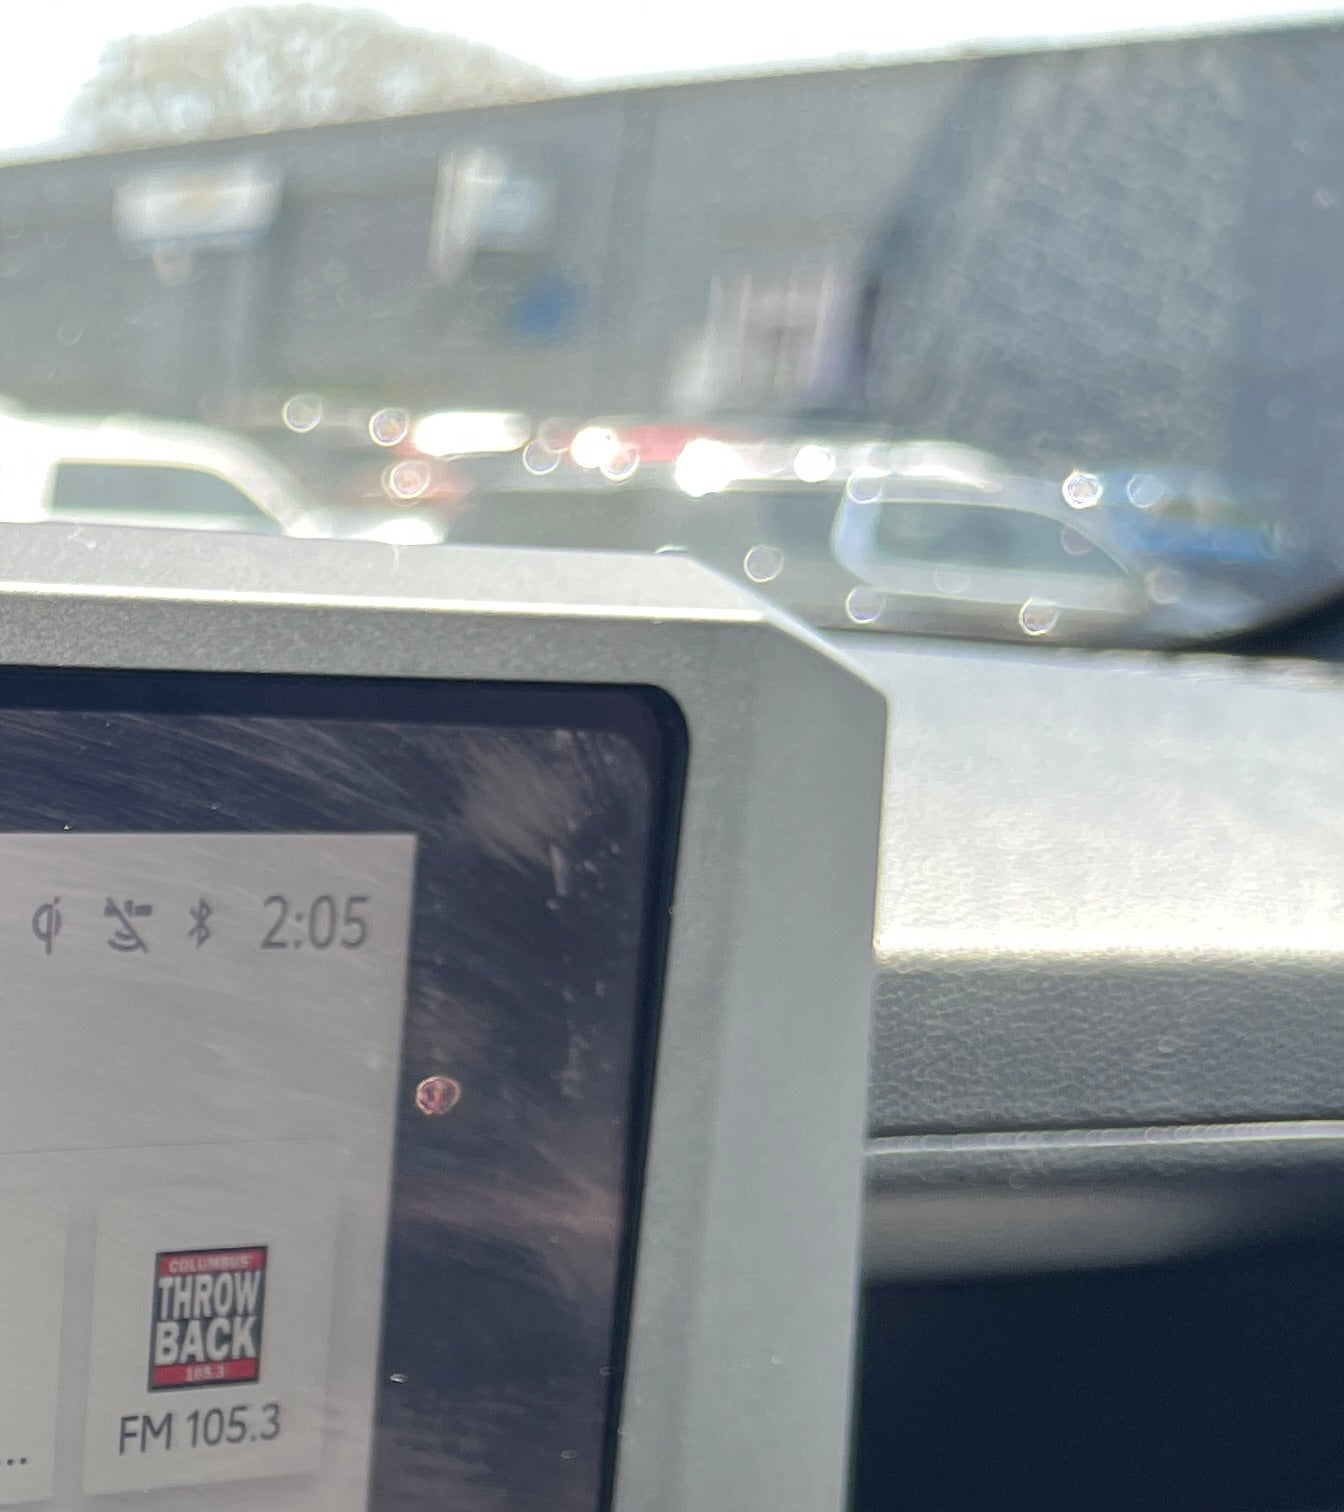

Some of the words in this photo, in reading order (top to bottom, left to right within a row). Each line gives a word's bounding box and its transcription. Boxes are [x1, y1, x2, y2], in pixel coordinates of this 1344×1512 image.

[260, 893, 371, 950] 2:05
[158, 1270, 262, 1321] THROW
[154, 1315, 258, 1367] BACK
[118, 1412, 174, 1455] FM
[187, 1402, 282, 1447] 105.3
